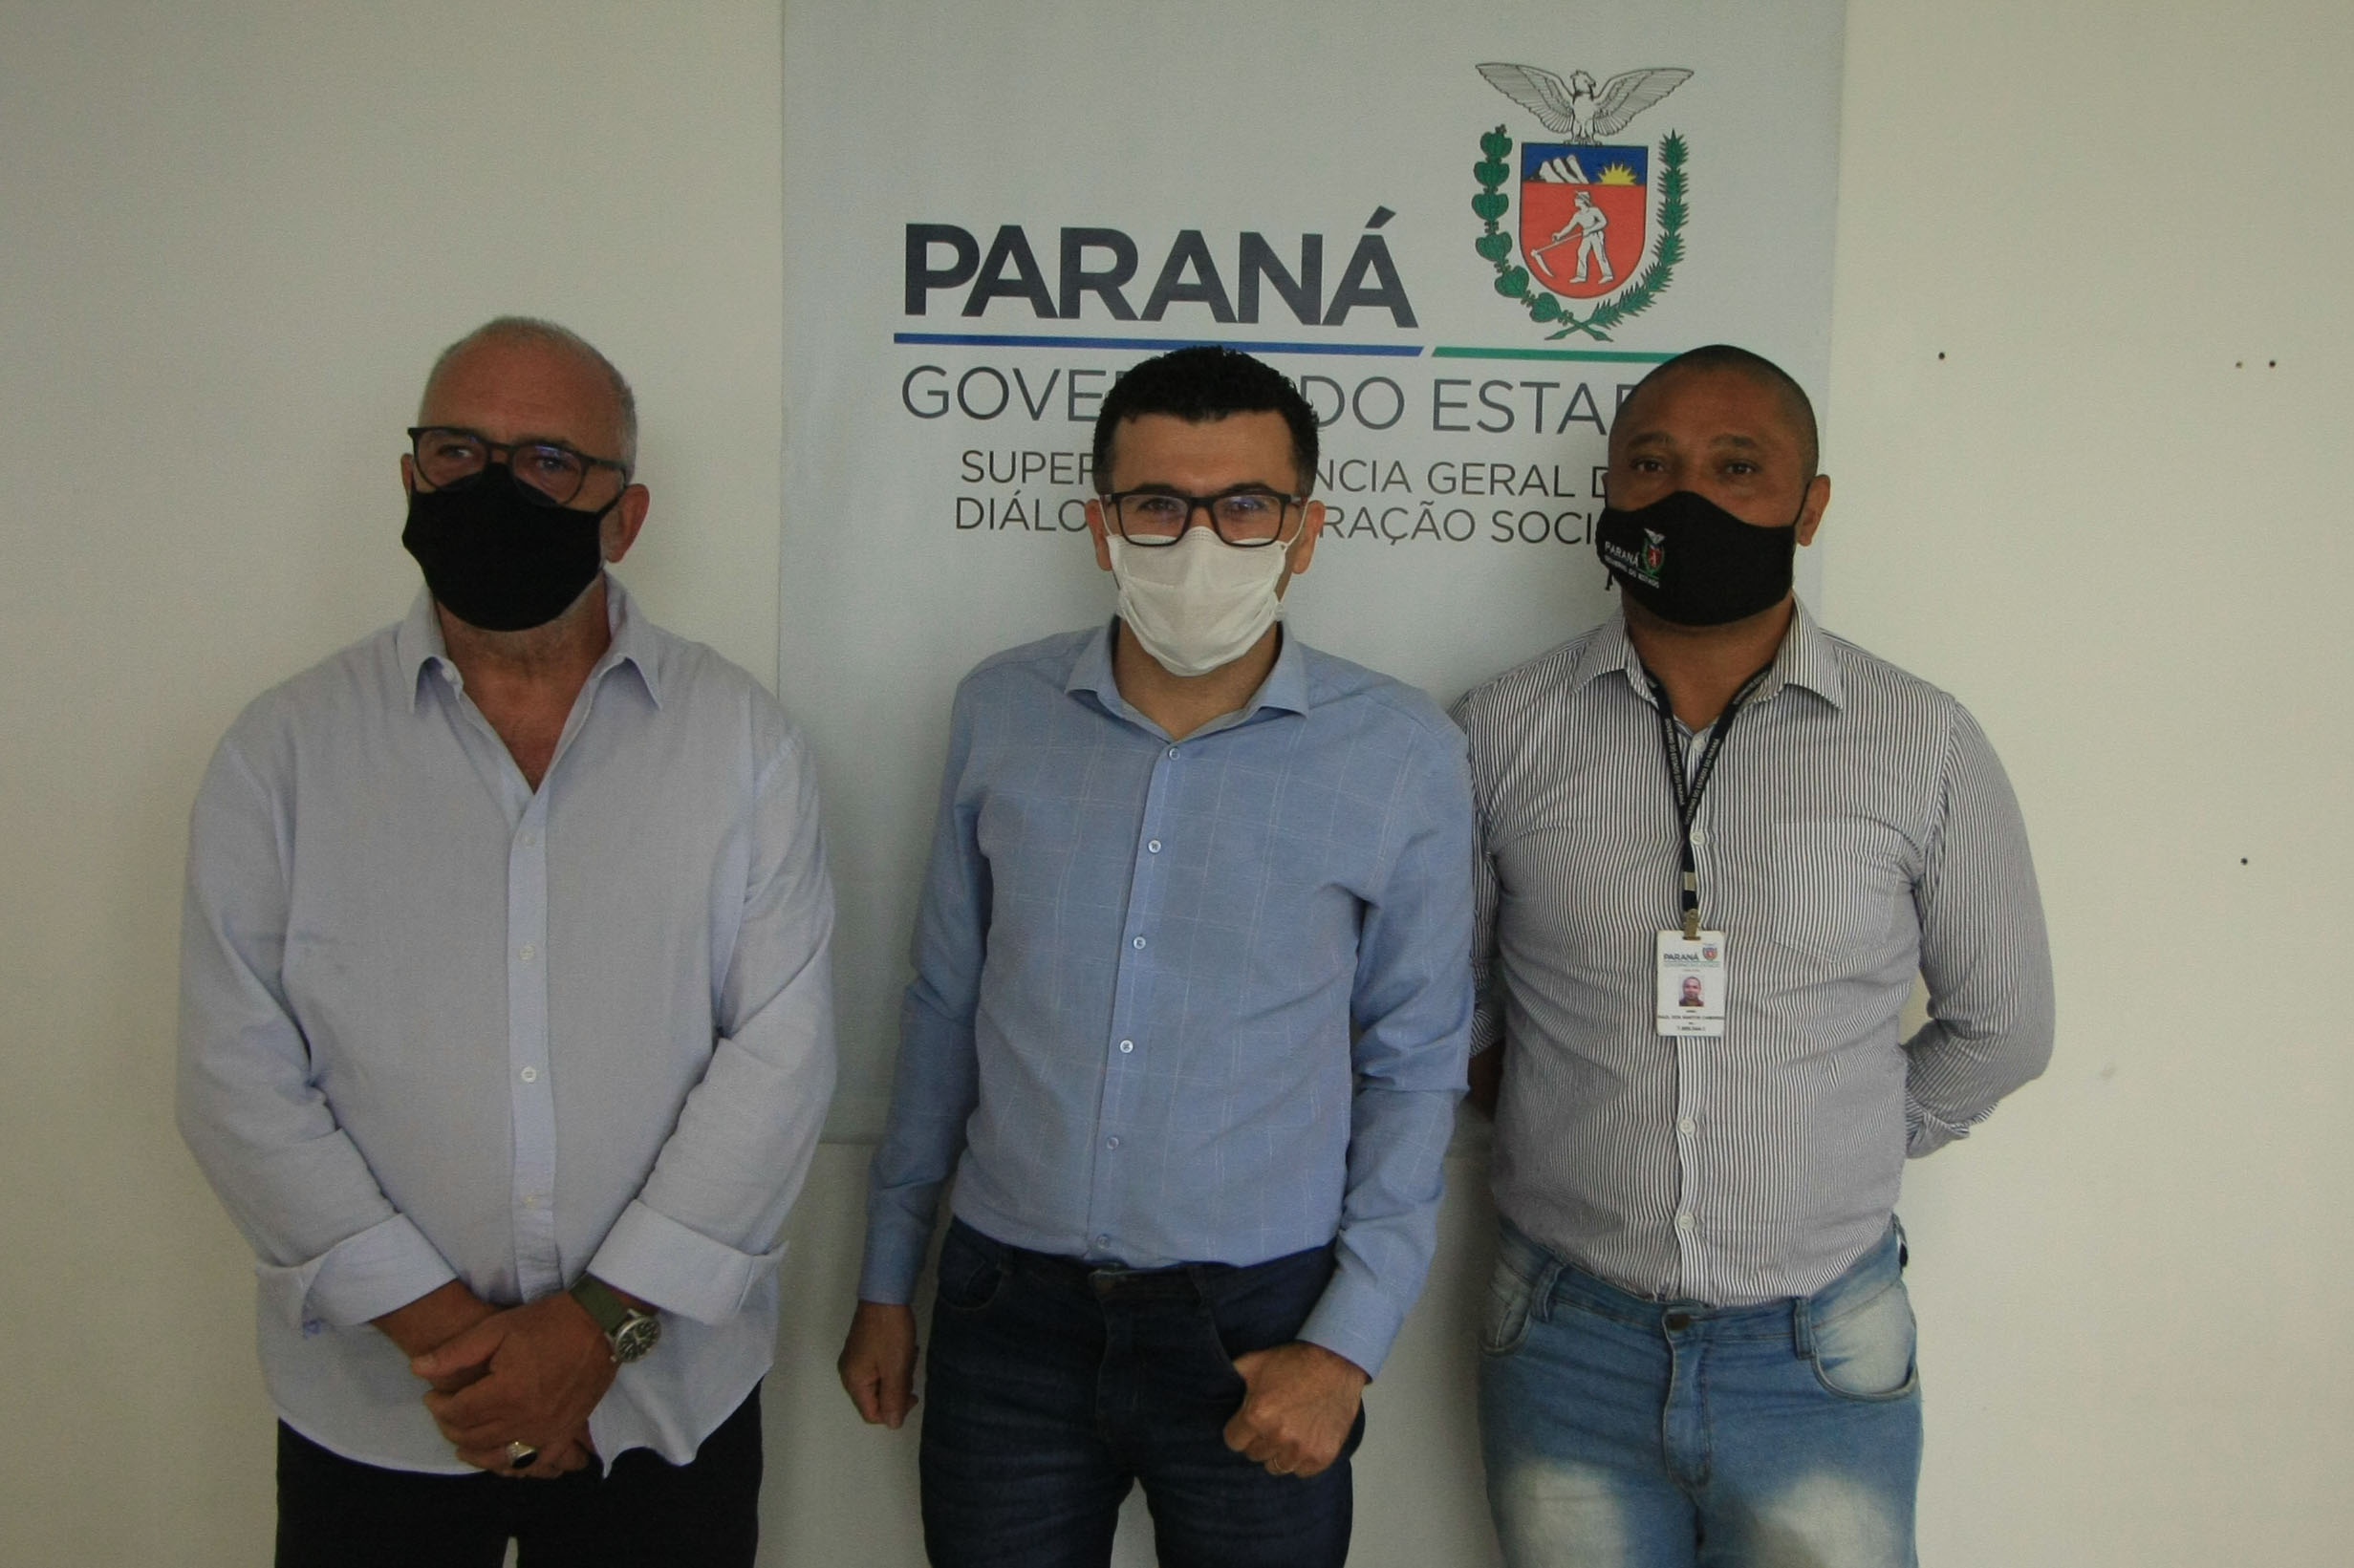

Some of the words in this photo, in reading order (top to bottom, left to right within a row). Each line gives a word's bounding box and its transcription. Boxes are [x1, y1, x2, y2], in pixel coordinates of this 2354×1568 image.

[904, 204, 1419, 329] PARANÁ
[902, 365, 1120, 421] GOVE
[1300, 375, 1405, 430] DO
[961, 450, 1094, 484] SUPER
[1315, 459, 1413, 493] NCIA
[1427, 462, 1576, 498] GERAL
[956, 489, 1089, 532] DIÁLO
[1318, 500, 1476, 546] RAÇÃO
[1491, 509, 1592, 545] SOCI
